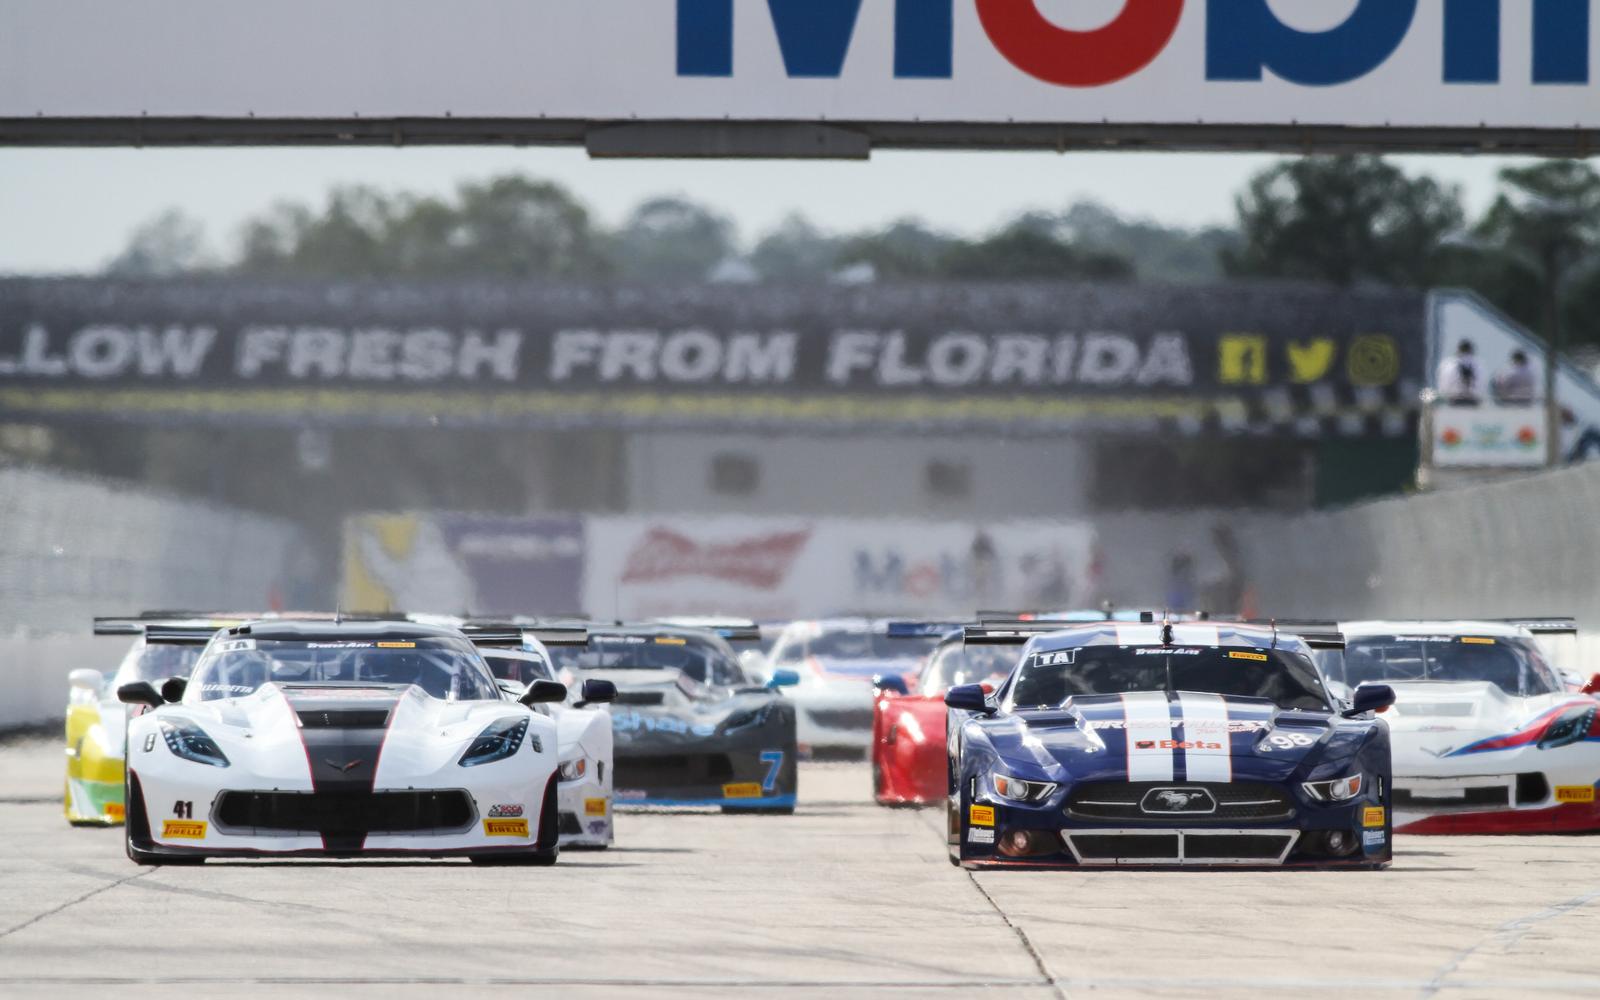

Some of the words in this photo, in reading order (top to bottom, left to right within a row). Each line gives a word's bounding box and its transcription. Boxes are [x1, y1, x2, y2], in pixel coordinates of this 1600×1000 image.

[0, 325, 216, 377] LOW
[237, 325, 521, 381] FRESH
[549, 328, 799, 383] FROM
[827, 328, 1193, 387] FLORIDA
[1041, 652, 1070, 665] TA
[1159, 739, 1222, 750] Beta
[1270, 733, 1314, 750] 98
[760, 751, 784, 791] 7
[173, 800, 193, 819] 41
[164, 822, 204, 837] PIRELLI
[487, 822, 528, 834] PIRELLI
